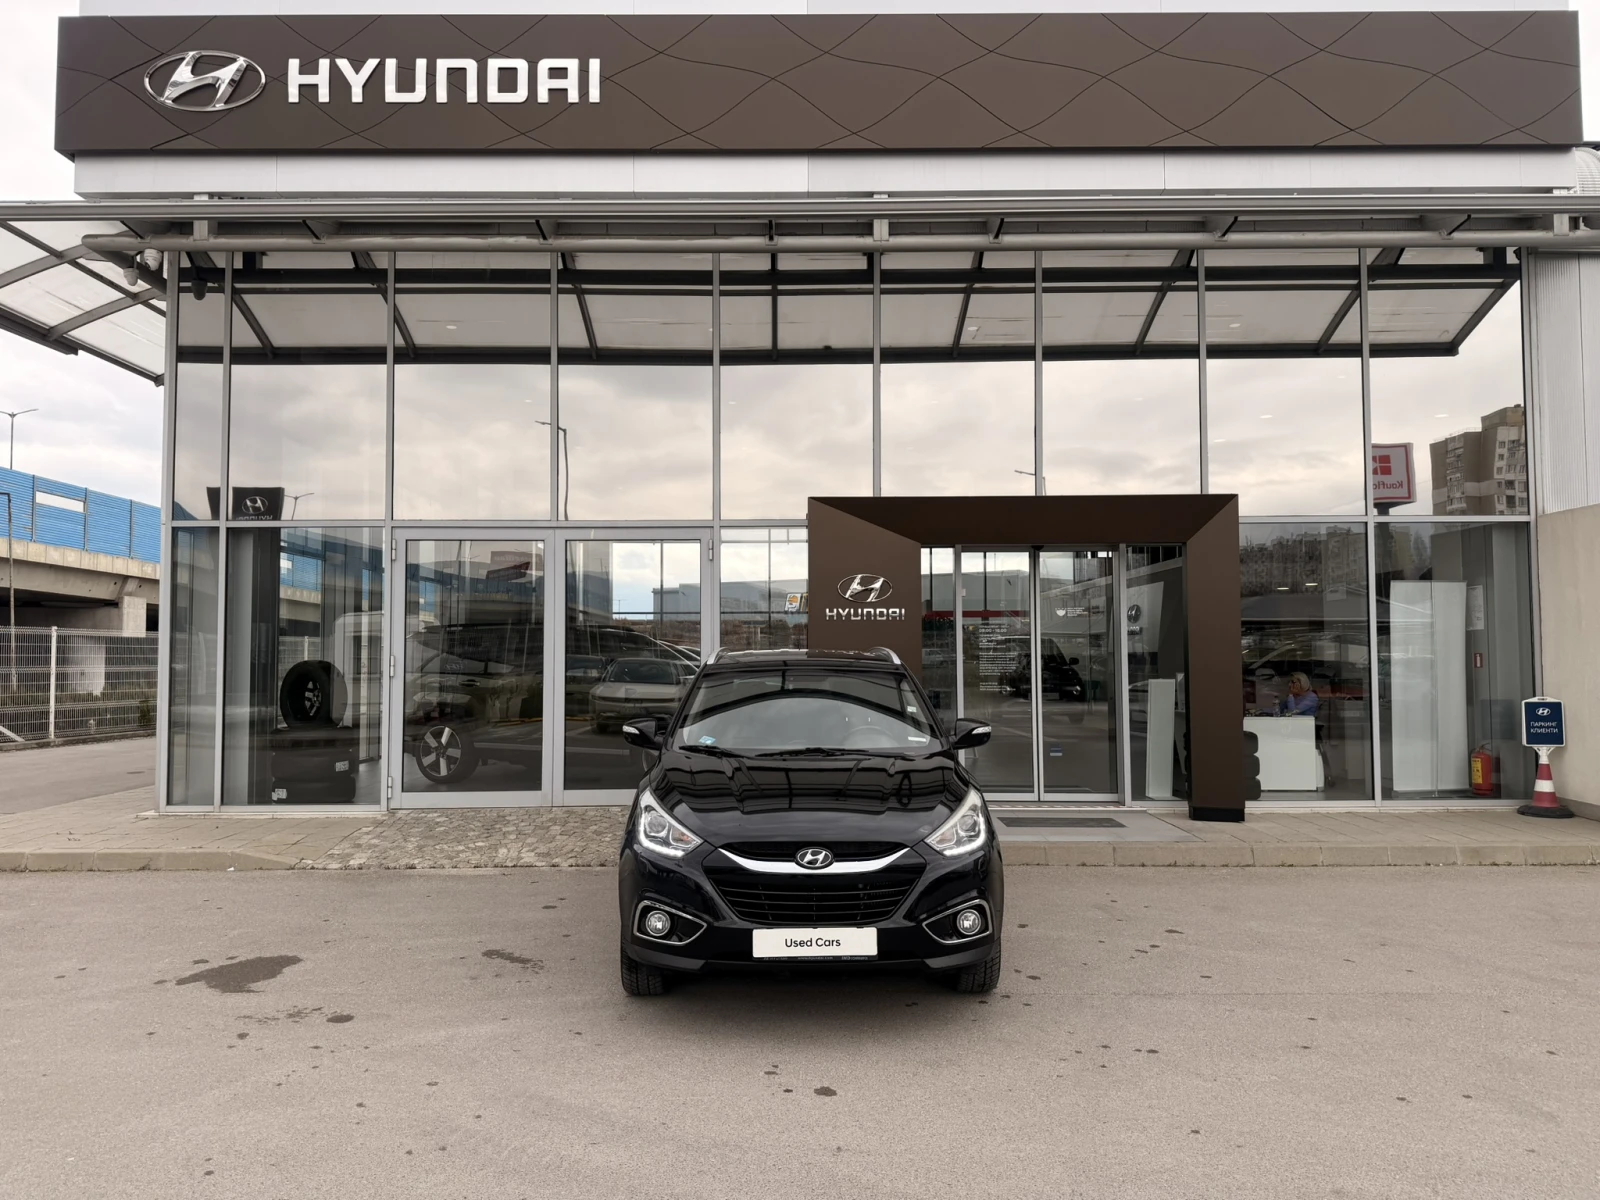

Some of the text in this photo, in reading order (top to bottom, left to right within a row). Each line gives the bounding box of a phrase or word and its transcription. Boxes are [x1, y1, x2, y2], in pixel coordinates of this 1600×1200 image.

[288, 58, 600, 103] HYUNDAI
[825, 608, 906, 621] HYUNDAI
[785, 937, 841, 948] Used Cars
